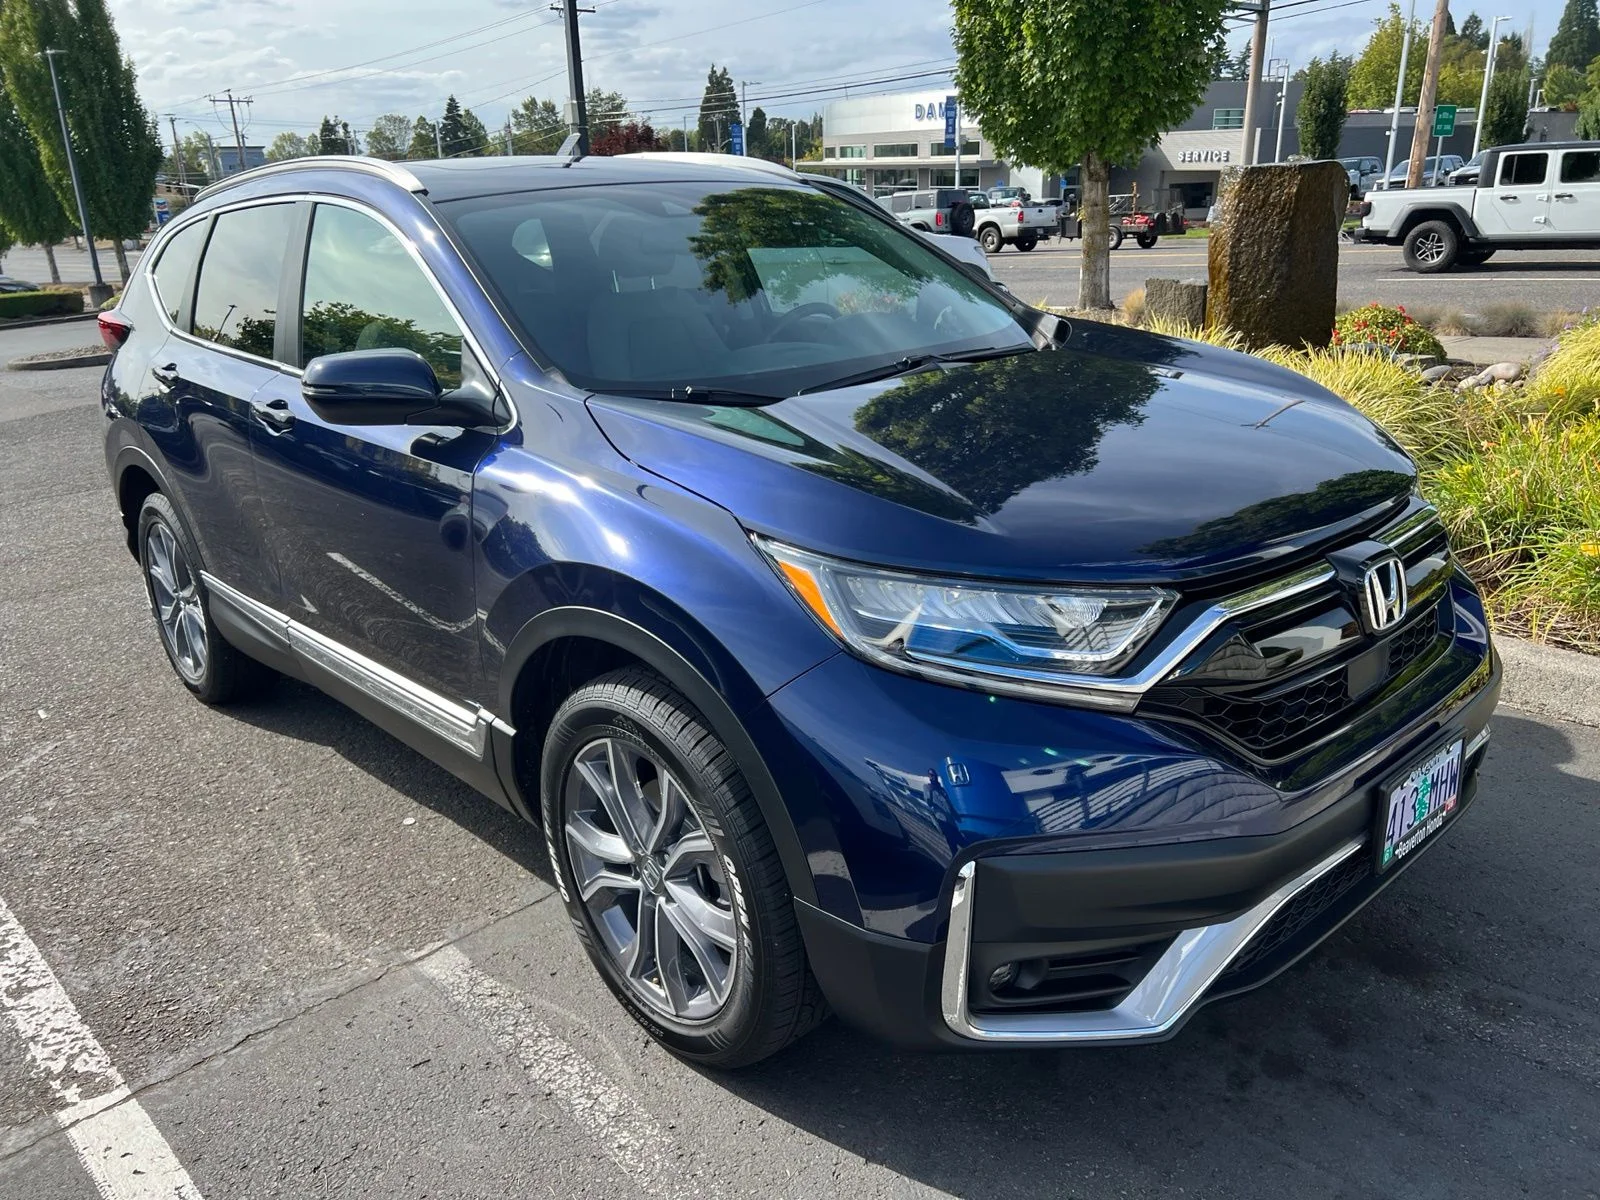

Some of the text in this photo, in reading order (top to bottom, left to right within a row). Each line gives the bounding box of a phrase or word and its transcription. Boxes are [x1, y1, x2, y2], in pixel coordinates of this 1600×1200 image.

[1177, 150, 1230, 162] SERVICE
[1386, 752, 1460, 847] 413 MHW
[1398, 826, 1426, 860] Beaverton
[1425, 810, 1443, 838] Honda
[722, 854, 751, 931] OPEN
